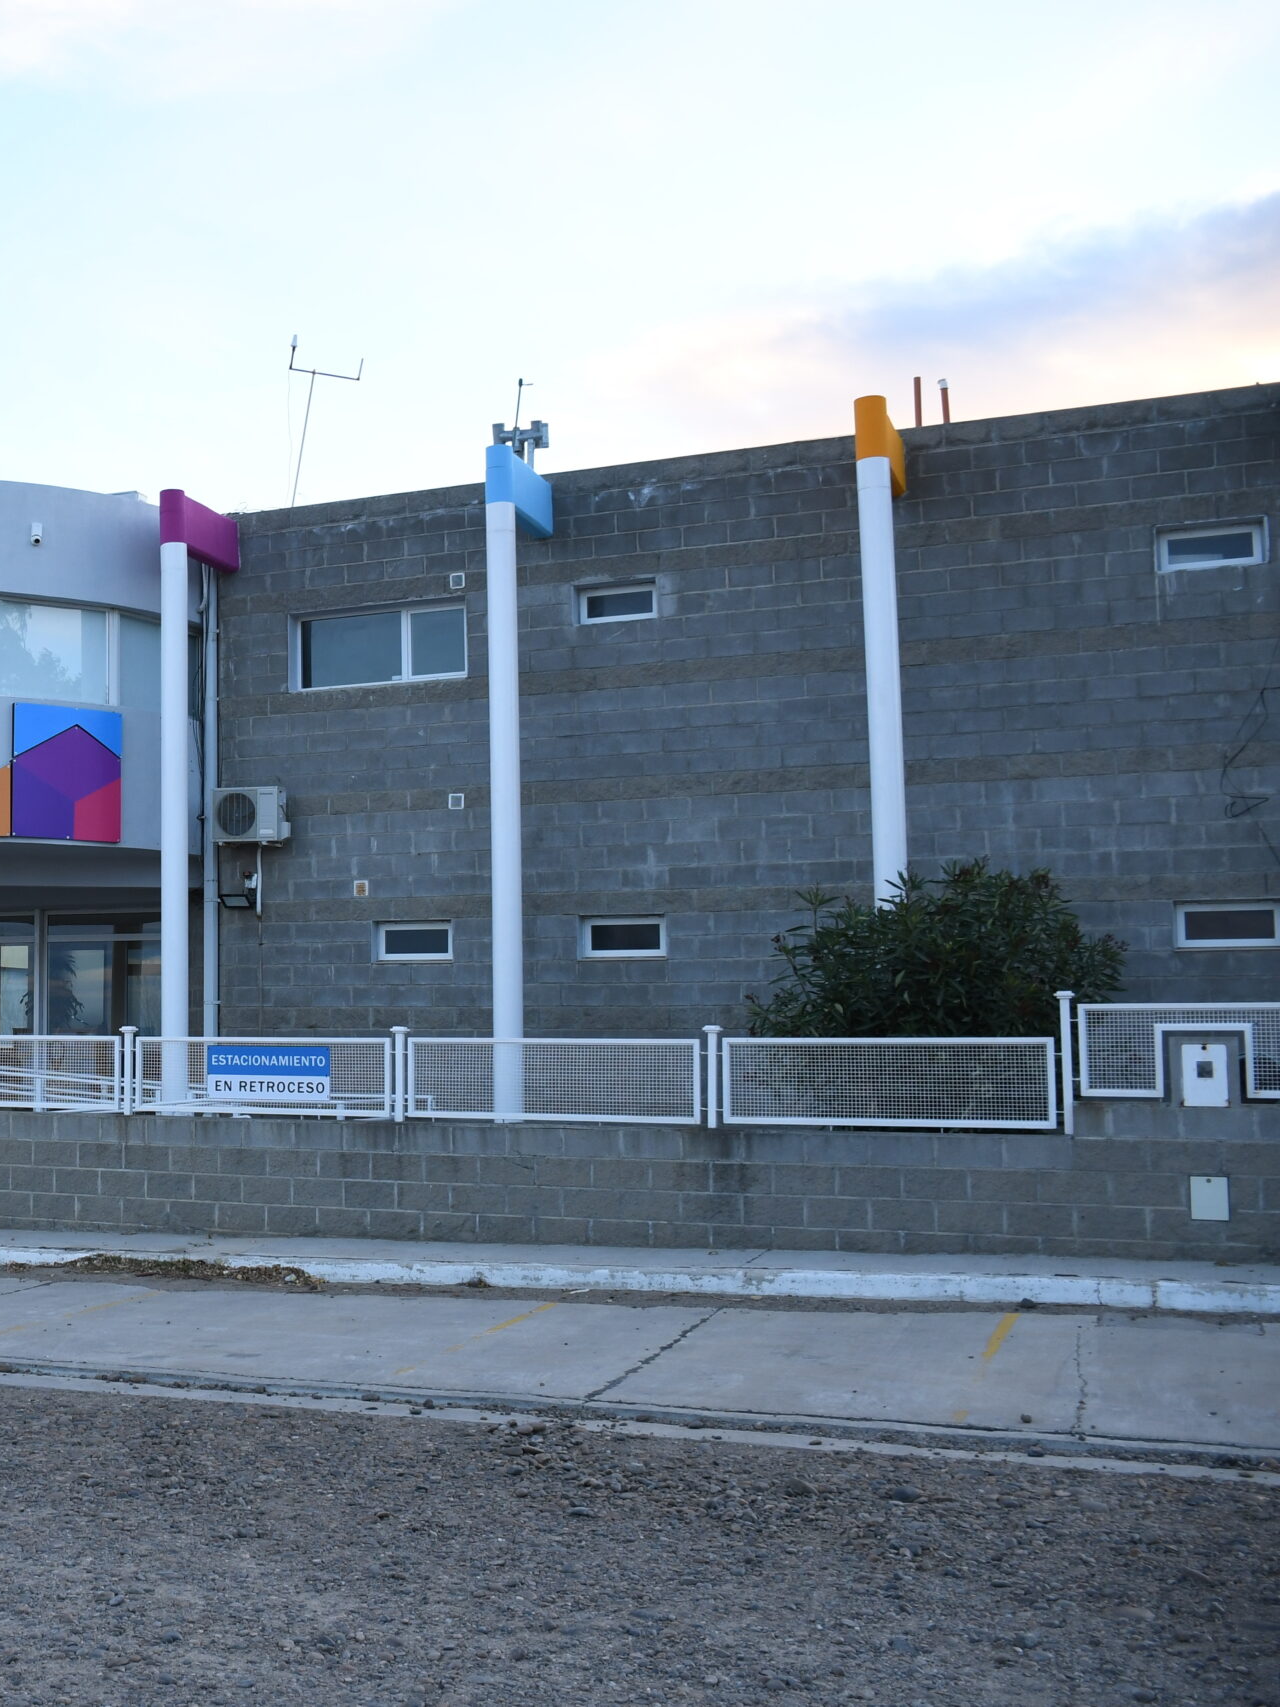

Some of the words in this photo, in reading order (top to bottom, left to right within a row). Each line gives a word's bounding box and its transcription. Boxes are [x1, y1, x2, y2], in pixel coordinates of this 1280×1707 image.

[211, 1054, 326, 1067] ESTACIONAMIENTO
[215, 1080, 232, 1092] EN
[239, 1080, 325, 1094] RETROCESO
